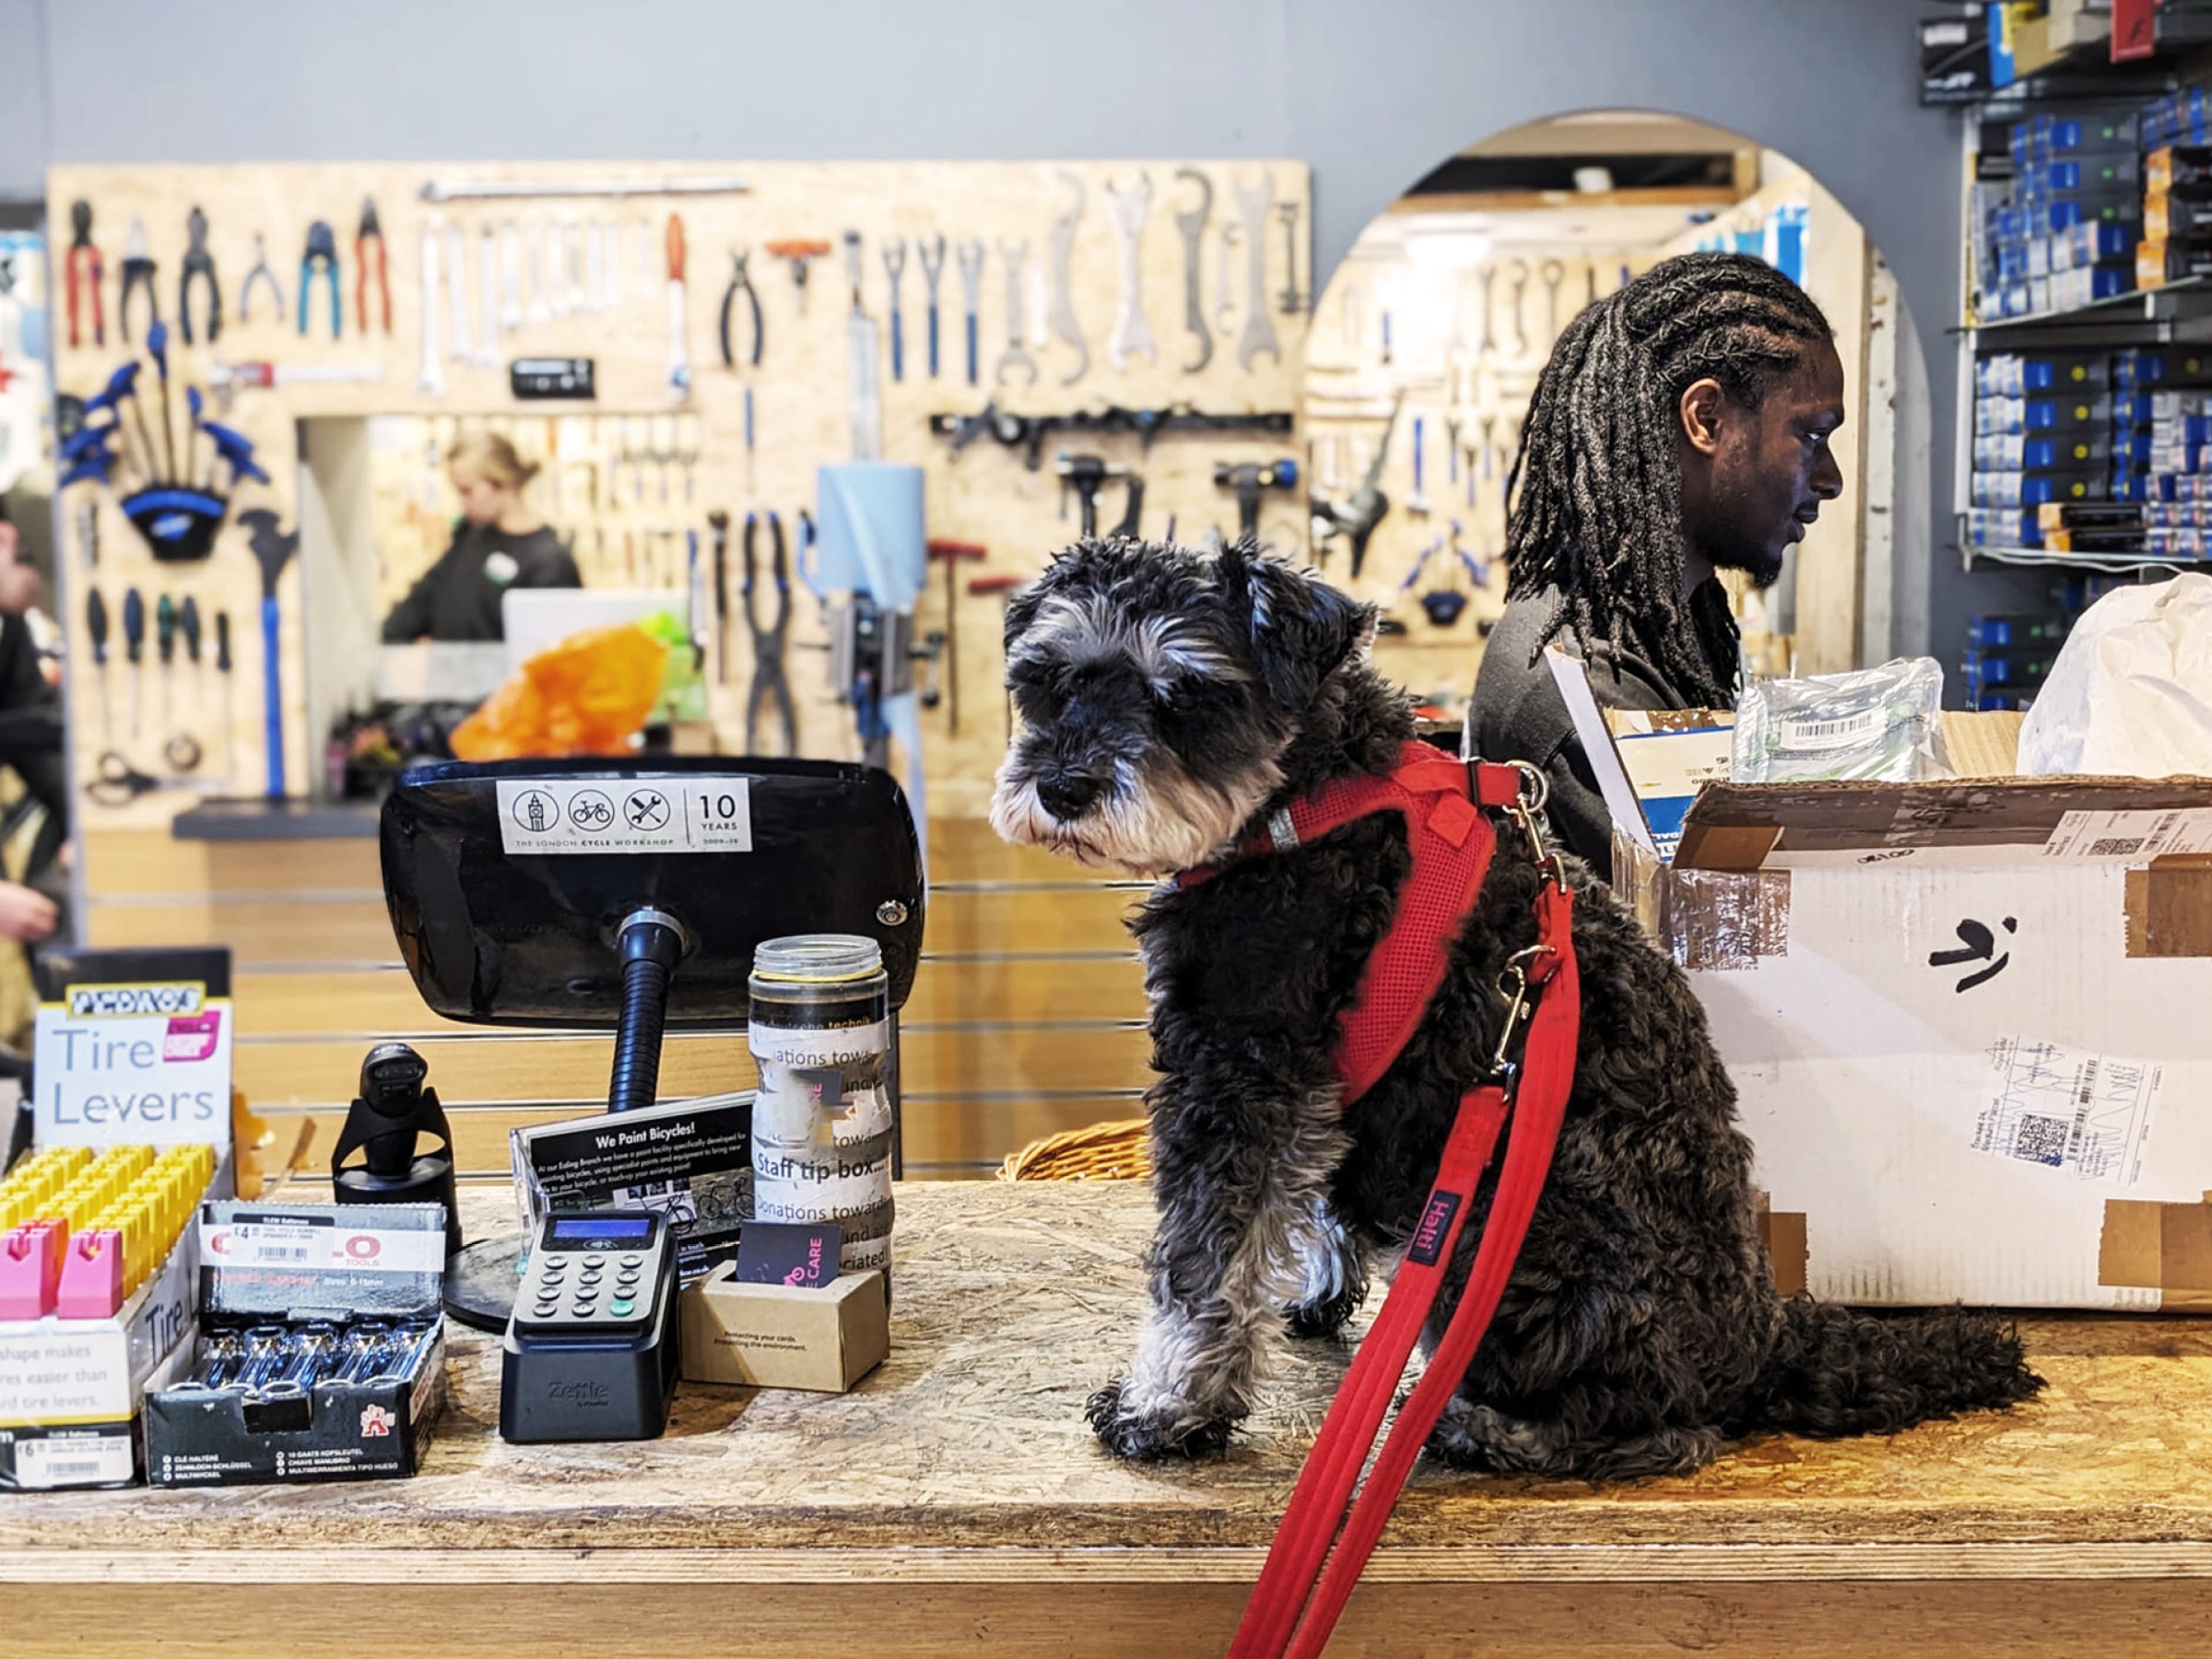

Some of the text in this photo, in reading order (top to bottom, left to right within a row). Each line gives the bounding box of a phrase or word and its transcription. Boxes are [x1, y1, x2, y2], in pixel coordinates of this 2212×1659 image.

[699, 794, 735, 819] 10
[52, 1030, 154, 1071] Tire
[53, 1082, 214, 1124] Levers
[595, 1121, 696, 1149] We Paint Bicycles!
[580, 1157, 601, 1166] Branch
[674, 1149, 704, 1162] equipment
[758, 1153, 794, 1177] Staff
[801, 1161, 830, 1183] tip
[758, 1194, 826, 1220] Donations
[346, 1258, 380, 1266] TOOLS
[806, 1238, 822, 1278] CARE
[146, 1299, 183, 1367] Tire
[46, 1347, 90, 1359] makes
[28, 1371, 70, 1383] easier
[75, 1370, 107, 1381] than
[22, 1396, 50, 1407] tire
[53, 1395, 100, 1407] levers.
[548, 1380, 608, 1399] Zettle
